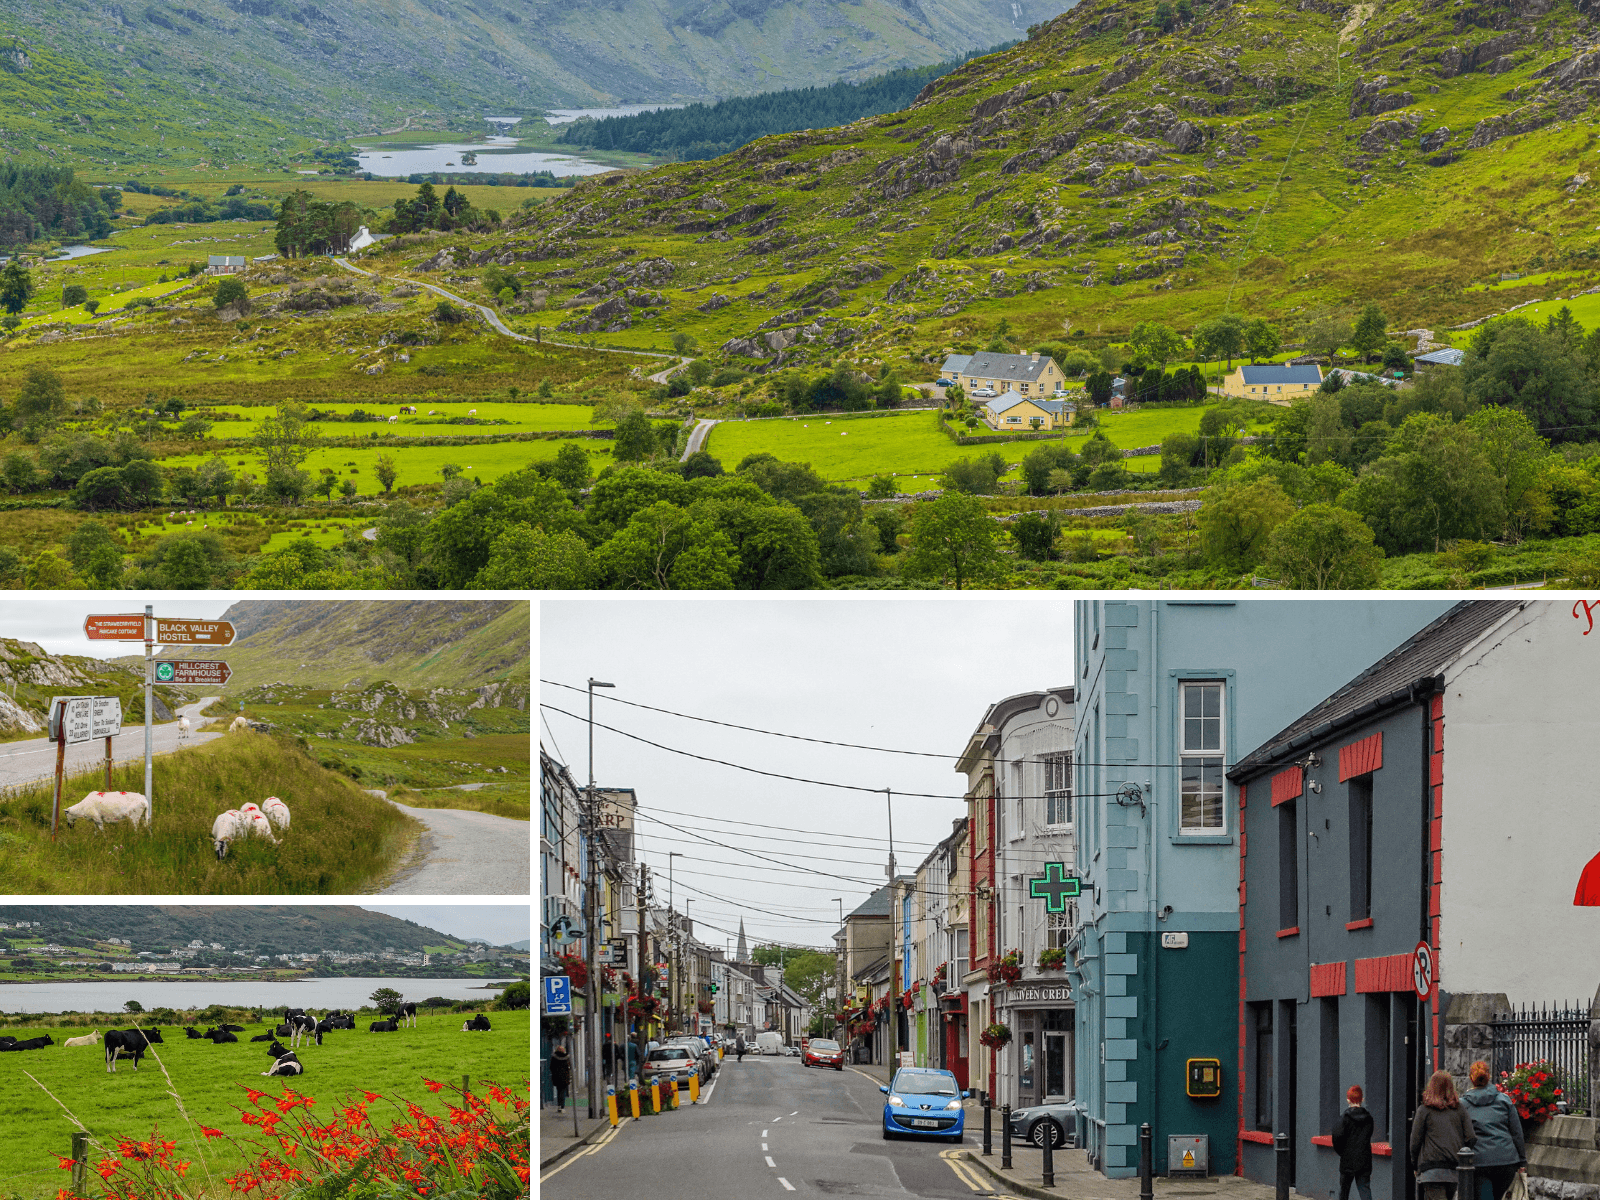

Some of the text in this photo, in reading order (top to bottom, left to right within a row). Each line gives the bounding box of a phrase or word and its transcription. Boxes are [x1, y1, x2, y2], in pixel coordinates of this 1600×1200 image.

[159, 624, 187, 632] BLACK
[159, 633, 192, 641] HOSTEL
[595, 814, 625, 826] ARP
[551, 978, 564, 994] P
[1042, 988, 1073, 1000] CRED
